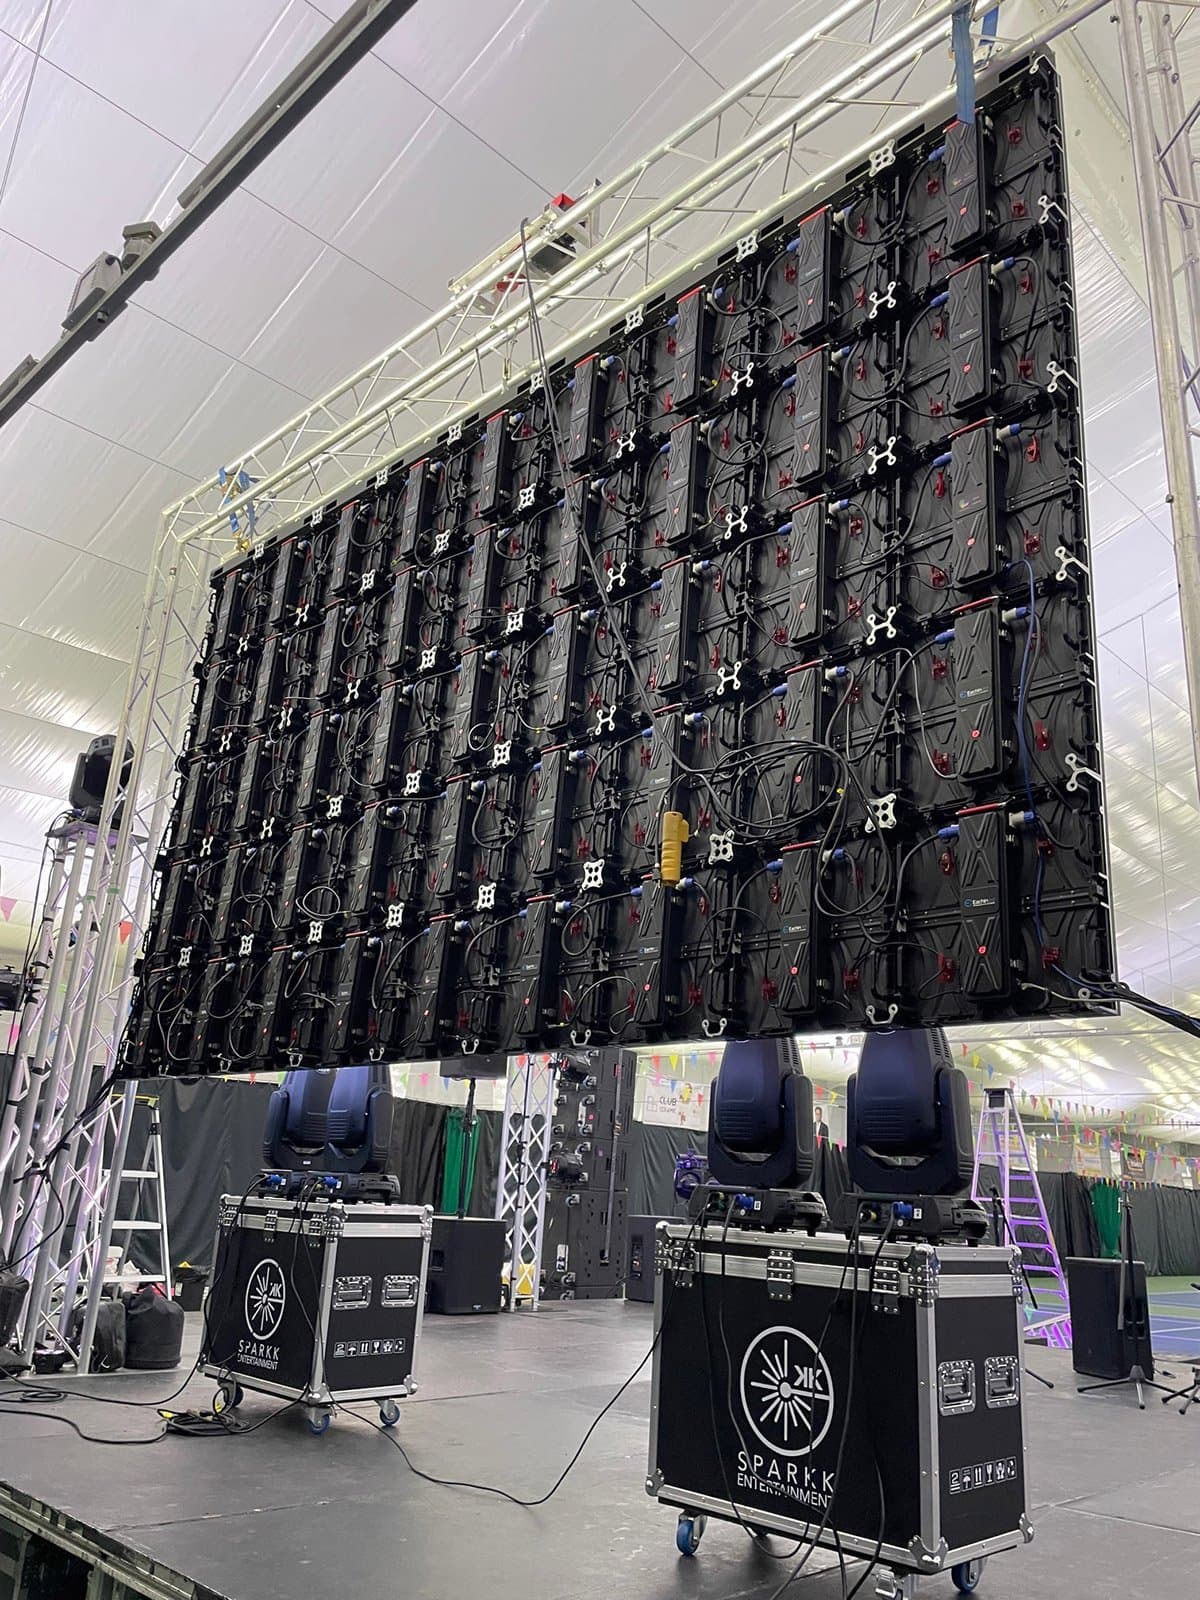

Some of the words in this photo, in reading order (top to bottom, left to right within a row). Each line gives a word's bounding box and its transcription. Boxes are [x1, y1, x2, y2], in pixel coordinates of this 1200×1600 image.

[659, 1095, 677, 1106] CLUB
[238, 1339, 280, 1361] SPARKK
[737, 1450, 835, 1493] SPARKK
